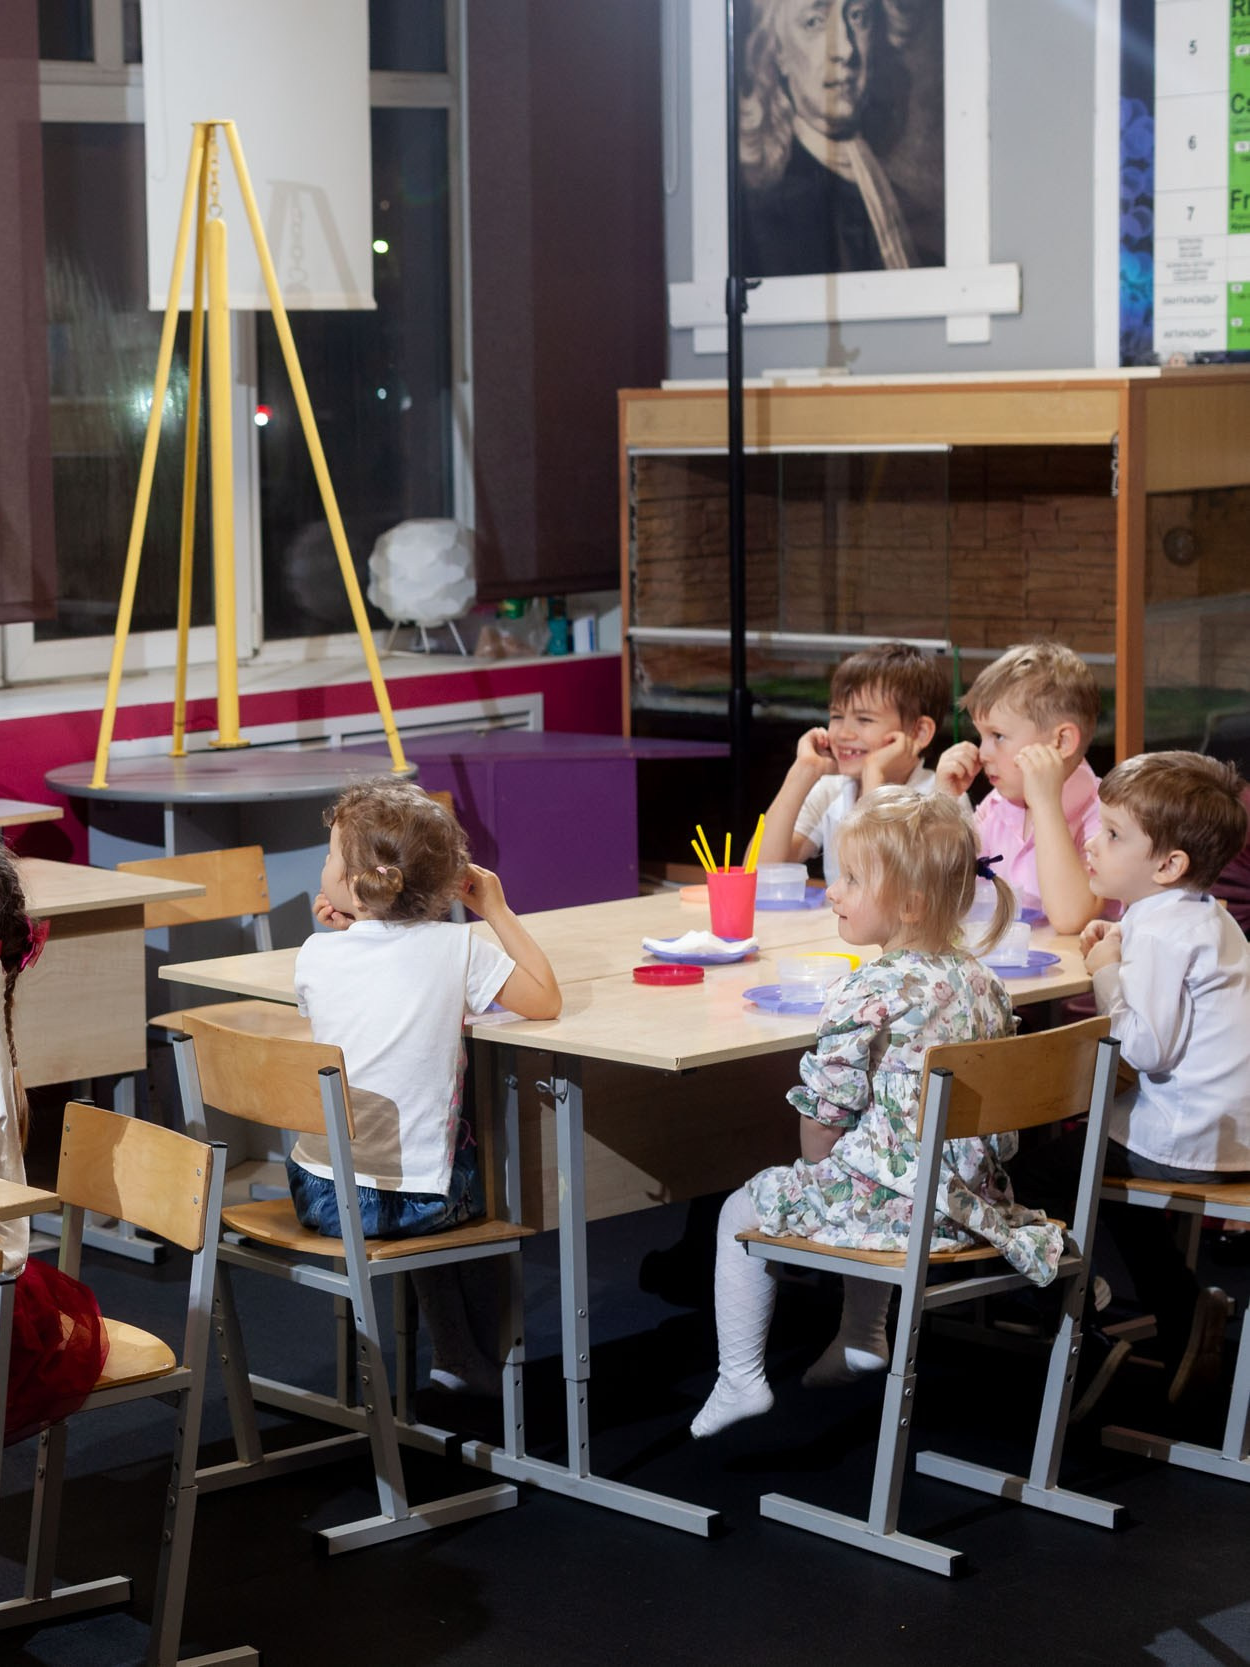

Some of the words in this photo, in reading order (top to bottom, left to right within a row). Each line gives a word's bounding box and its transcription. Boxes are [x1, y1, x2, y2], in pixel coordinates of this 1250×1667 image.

[1231, 0, 1250, 18] R
[1188, 40, 1198, 55] 5
[1188, 135, 1197, 151] 6
[1186, 206, 1195, 221] 7
